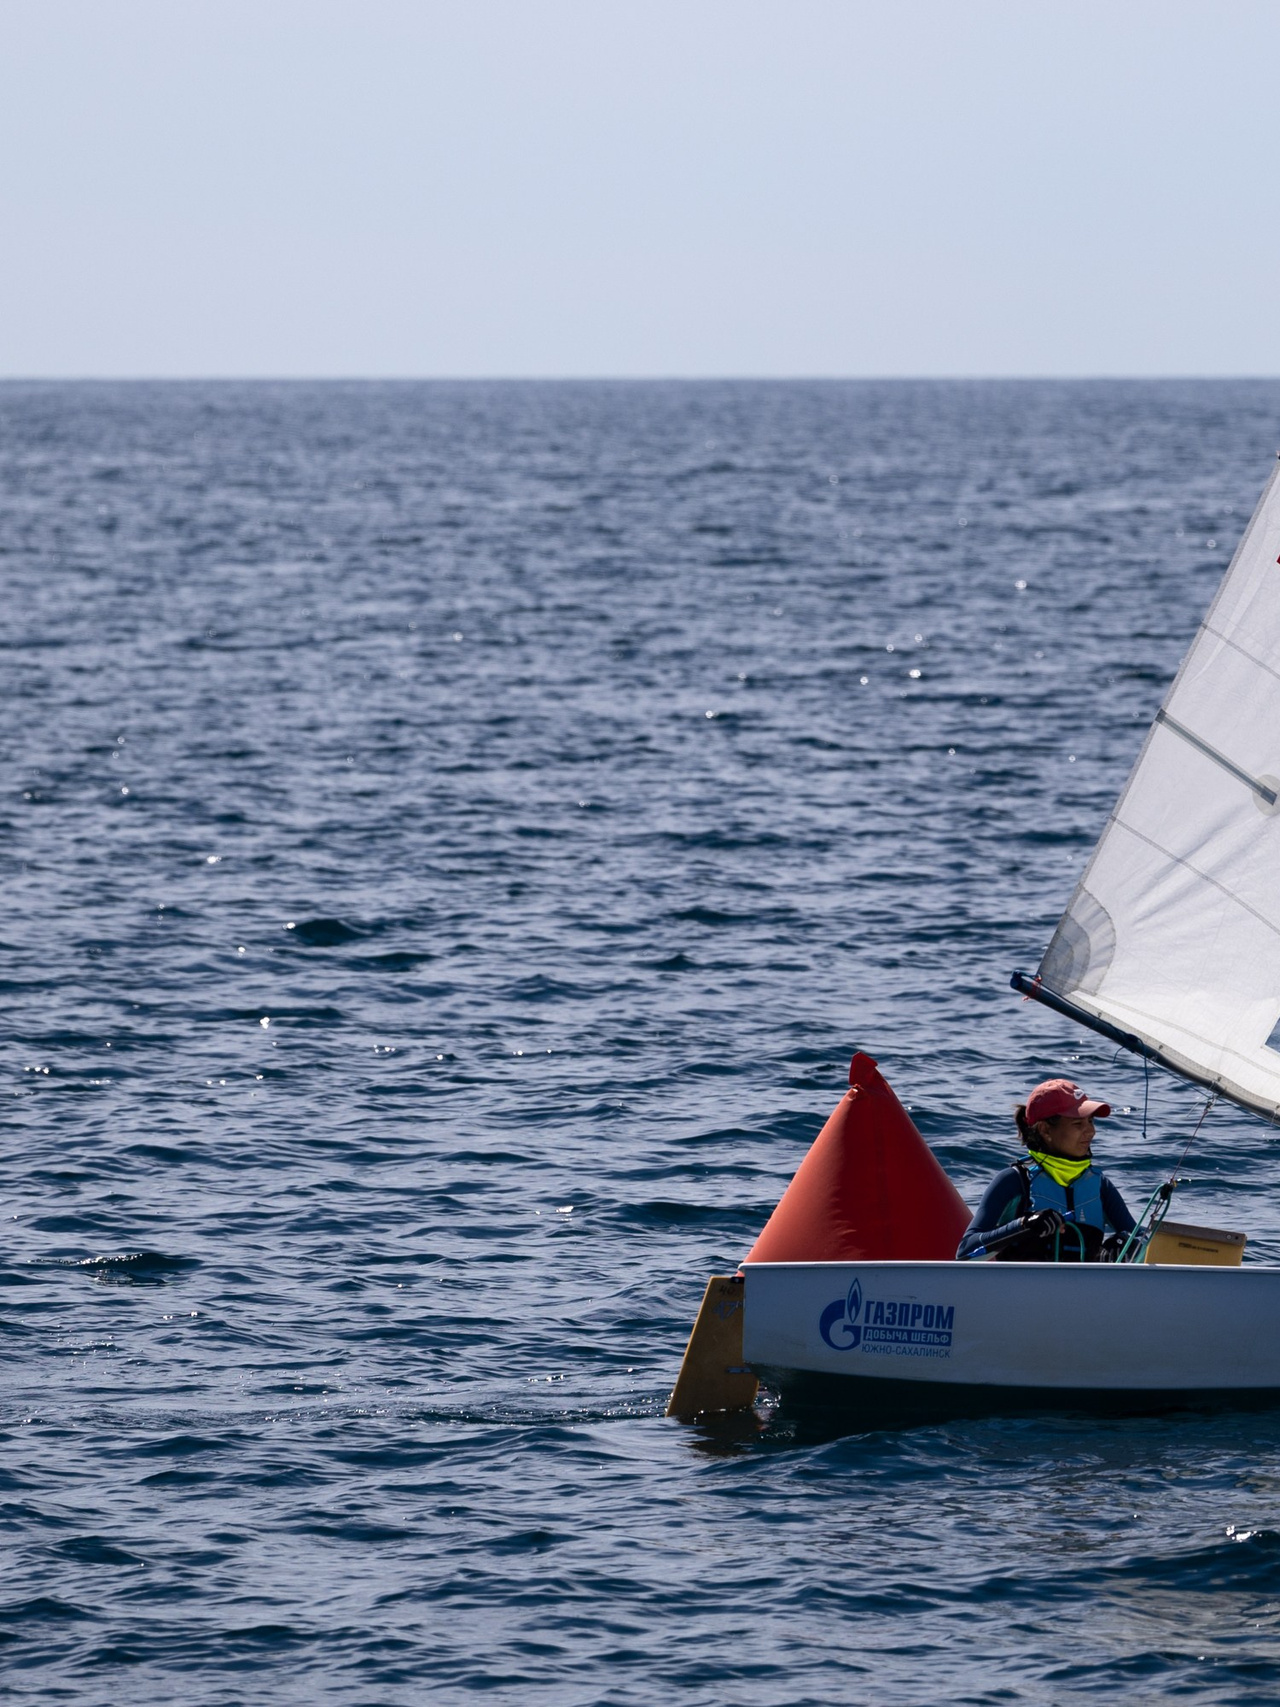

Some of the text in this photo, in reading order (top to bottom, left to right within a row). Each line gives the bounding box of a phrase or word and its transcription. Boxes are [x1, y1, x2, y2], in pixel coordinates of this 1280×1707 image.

[864, 1300, 955, 1330] ГАЗПРОМ
[865, 1328, 950, 1345] ДОБЫЧА ШЕЛЬФ
[861, 1343, 952, 1358] ЮЖНО-САХАЛИНСК
